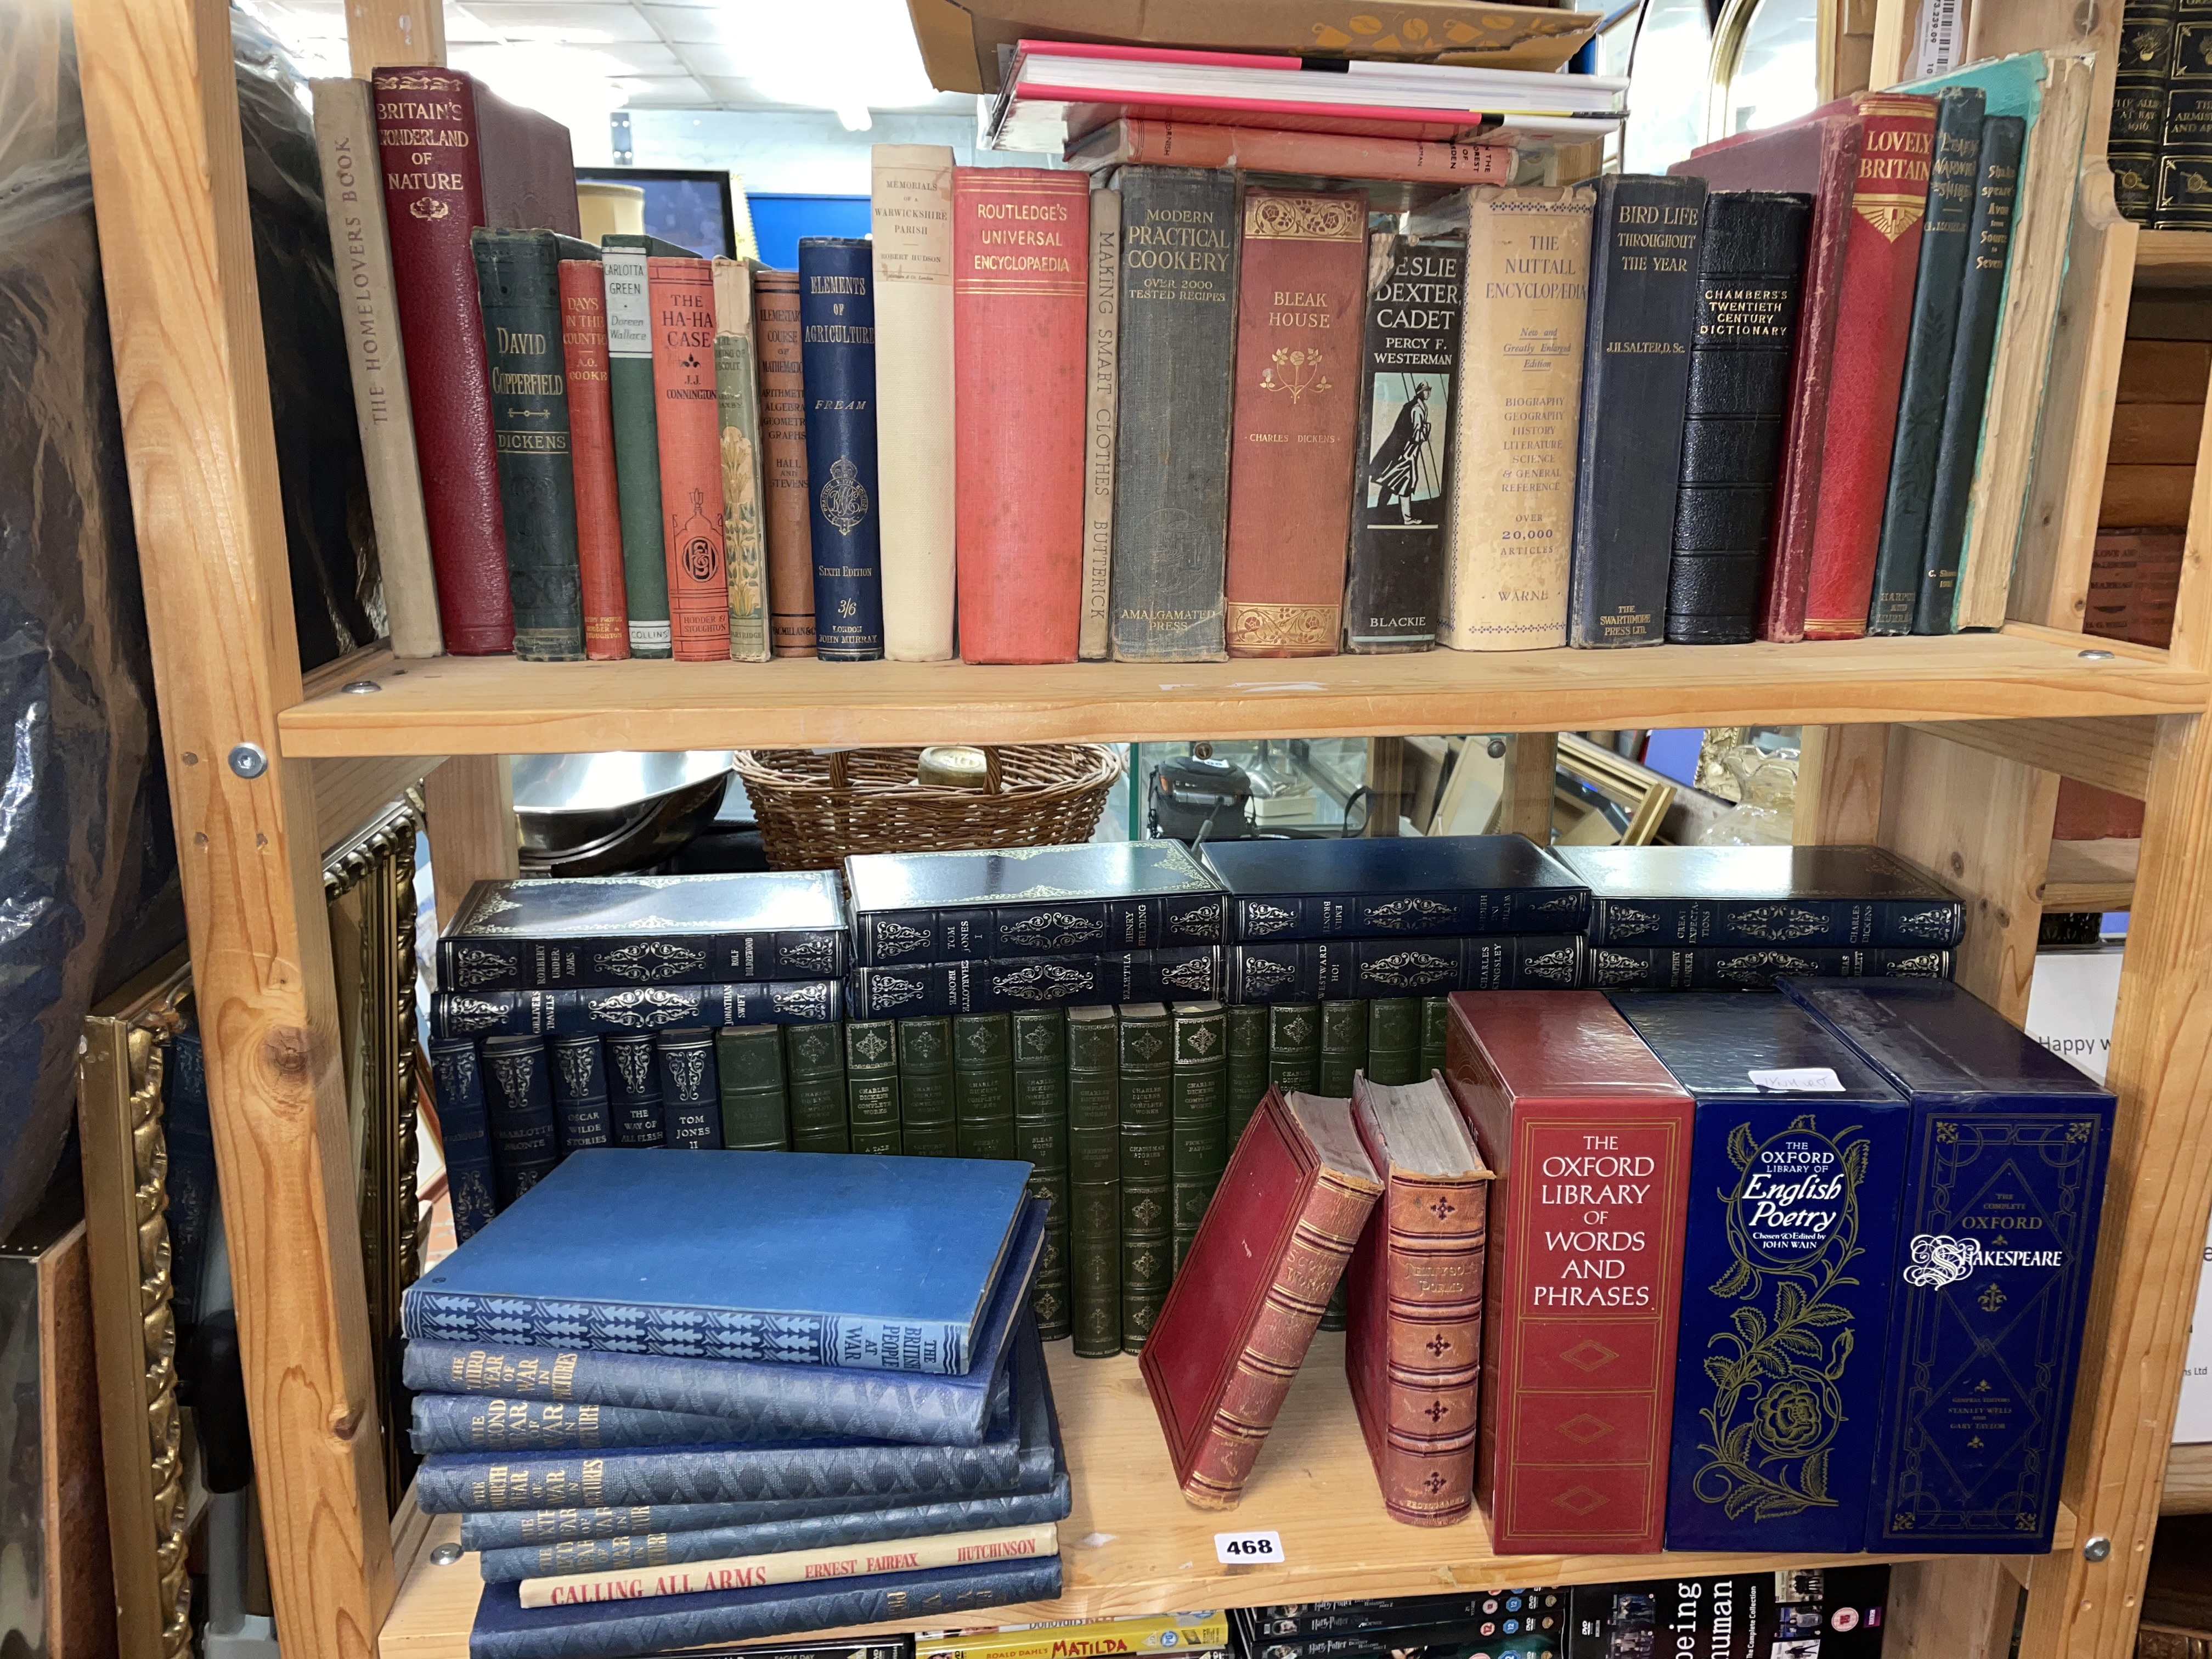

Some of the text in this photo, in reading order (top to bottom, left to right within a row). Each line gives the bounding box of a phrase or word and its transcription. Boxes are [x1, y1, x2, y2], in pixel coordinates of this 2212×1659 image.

[377, 102, 462, 121] BRITAIN'S
[1866, 131, 1933, 154] LOVELY
[411, 153, 431, 165] OF
[1858, 159, 1930, 180] BRITAIN
[388, 173, 464, 190] NATURE
[887, 180, 938, 191] MEMORIALS
[875, 207, 947, 221] WARWICKSHIRE
[977, 204, 1067, 221] ROUTLEDGE'S
[1146, 209, 1214, 223] MODERN
[1618, 206, 1698, 225] BIRD LIFE
[894, 225, 928, 235] PARISH
[1128, 226, 1230, 249] PRACTICAL
[982, 230, 1063, 246] UNIVERSAL
[1530, 235, 1559, 251] THE
[1617, 233, 1695, 249] THROUGHOUT
[974, 255, 1070, 273] ENCYCLOPAEDIA
[1128, 250, 1229, 272] COOKERY
[1395, 257, 1457, 278] ESLIE
[1505, 258, 1576, 275] NUTTALL
[1622, 256, 1687, 272] THE YEAR
[605, 264, 644, 276] CARLOTTA
[334, 137, 388, 425] THE HOMELOVERS BOOK
[810, 276, 866, 295] ELEMENTS
[1144, 279, 1213, 290] OVER 2000
[610, 283, 640, 295] GREEN
[1129, 290, 1226, 302] TESTED RECIPES
[1374, 283, 1462, 306] DEXTER,
[1705, 290, 1787, 300] CHAMBERS'S
[568, 297, 599, 312] DAYS
[670, 295, 703, 307] THE
[1273, 291, 1328, 307] BLEAK
[833, 303, 844, 315] OF
[1709, 302, 1782, 312] TWENTIETH
[612, 315, 644, 326] Doreen
[662, 311, 714, 328] HA-HA
[1268, 312, 1330, 328] HOUSE
[1376, 309, 1455, 330] CADET
[1717, 313, 1774, 324] CENTURY
[610, 330, 646, 340] Wallace
[805, 325, 874, 344] AGRICULTURE
[1520, 328, 1538, 336] New
[1700, 325, 1787, 335] DICTIONARY
[497, 328, 546, 354] DAVID
[668, 331, 711, 347] CASE
[1386, 337, 1447, 350] PERCY F.
[1503, 343, 1571, 355] Greatly Enlarged
[1374, 352, 1452, 365] WESTERMAN
[1523, 359, 1551, 368] Edition
[493, 367, 563, 396] COPPERFIELD
[569, 371, 607, 381] COOKE
[815, 400, 867, 409] FREAM
[1505, 397, 1564, 407] BIOGRAPHY
[1504, 411, 1564, 421] GEOGRAPHY
[1091, 232, 1114, 619] MAKING SMART CLOTHES BUTTERICK
[1512, 426, 1556, 436] HISTORY
[498, 434, 566, 449] DICKENS
[1250, 433, 1335, 443] CHARLES DICKENS
[1504, 440, 1562, 450] LITERATURE
[776, 459, 802, 468] HALL
[1512, 454, 1555, 465] SCIENCE
[1516, 469, 1562, 478] GENERAL
[1502, 482, 1560, 493] REFERENCE
[1515, 514, 1543, 523] OVER
[1502, 529, 1554, 541] 20,000
[1500, 546, 1554, 556] ARTICLES
[1498, 590, 1549, 602] WARNE
[1121, 610, 1215, 620] AMALGAMATED
[1618, 605, 1635, 613] THE
[1149, 621, 1188, 631] PRESS
[1369, 616, 1426, 628] BLACKIE
[1600, 614, 1651, 625] SWARTHMORE
[631, 630, 668, 639] COLLINS
[1605, 626, 1646, 635] PRESS LTD.
[1125, 911, 1134, 943] HENRY
[1137, 904, 1147, 946] FIELDING
[947, 926, 956, 950] TOM
[961, 921, 969, 953] JONES
[535, 944, 546, 985] ROBBERY
[566, 952, 575, 977] ARMS
[745, 938, 753, 977] BOLDREWOOD
[1318, 945, 1327, 999] WESTWARD
[1331, 964, 1340, 982] HO!
[1493, 943, 1502, 990] KINGSLEY
[961, 960, 970, 1012] CHARLOTTE
[546, 994, 555, 1030] TRAVELS
[724, 985, 734, 1026] JONATHAN
[737, 994, 746, 1018] SWIFT
[2039, 1036, 2095, 1055] Happy
[859, 1086, 890, 1094] CHARLES
[568, 1111, 600, 1122] OSCAR
[679, 1115, 704, 1125] TOM
[569, 1124, 602, 1135] WILDE
[676, 1127, 711, 1139] JONES
[1583, 1136, 1618, 1150] THE
[1786, 1142, 1809, 1150] THE
[1761, 1152, 1835, 1164] OXFORD
[1542, 1156, 1655, 1178] OXFORD
[1542, 1184, 1651, 1205] LIBRARY
[1742, 1173, 1844, 1206] English
[1583, 1210, 1609, 1226] OF
[1748, 1201, 1837, 1232] Poetry
[1961, 1216, 2043, 1229] OXFORD
[1545, 1231, 1646, 1252] WORDS
[1817, 1232, 1826, 1240] by
[1763, 1241, 1788, 1249] JOHN
[1561, 1259, 1625, 1280] AND
[1903, 1234, 2063, 1291] SHAKESPEARE
[1533, 1286, 1650, 1307] PHRASES
[844, 1326, 862, 1361] WAR
[881, 1324, 900, 1368] PEOPLE
[903, 1326, 922, 1370] BRITISH
[924, 1340, 936, 1363] THE
[1227, 1539, 1273, 1555] 468
[551, 1538, 1036, 1604] CALLING ALL ARMS ERNEST FAIRFAX HUTCHINSON
[1839, 1614, 1850, 1623] 15
[1483, 1624, 1492, 1635] 12
[1582, 1621, 1590, 1635] DVD
[1018, 1647, 1048, 1657] DAHL'S
[1051, 1639, 1127, 1659] MATILDA
[1308, 1643, 1327, 1655] Harry
[1327, 1640, 1347, 1654] Potter
